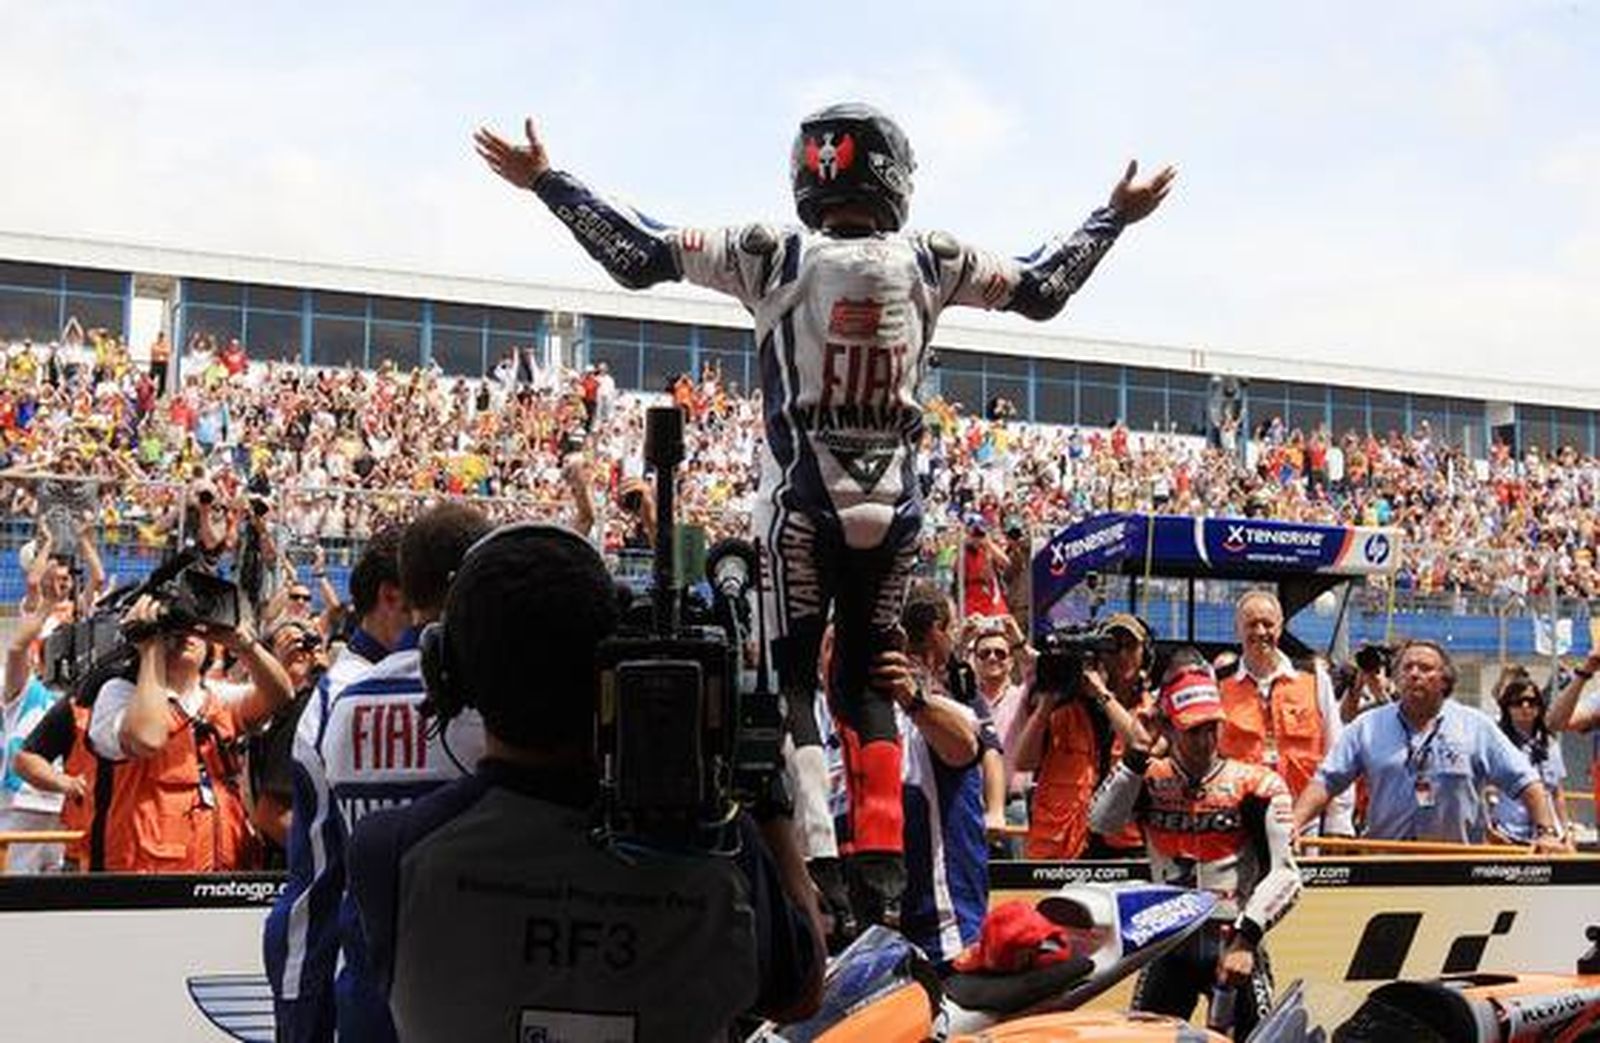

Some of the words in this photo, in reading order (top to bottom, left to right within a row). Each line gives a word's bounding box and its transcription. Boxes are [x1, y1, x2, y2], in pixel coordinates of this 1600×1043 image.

[820, 342, 907, 410] FIAT
[193, 881, 288, 901] motogp.c
[1300, 866, 1350, 881] gp.com
[524, 917, 637, 970] RF3
